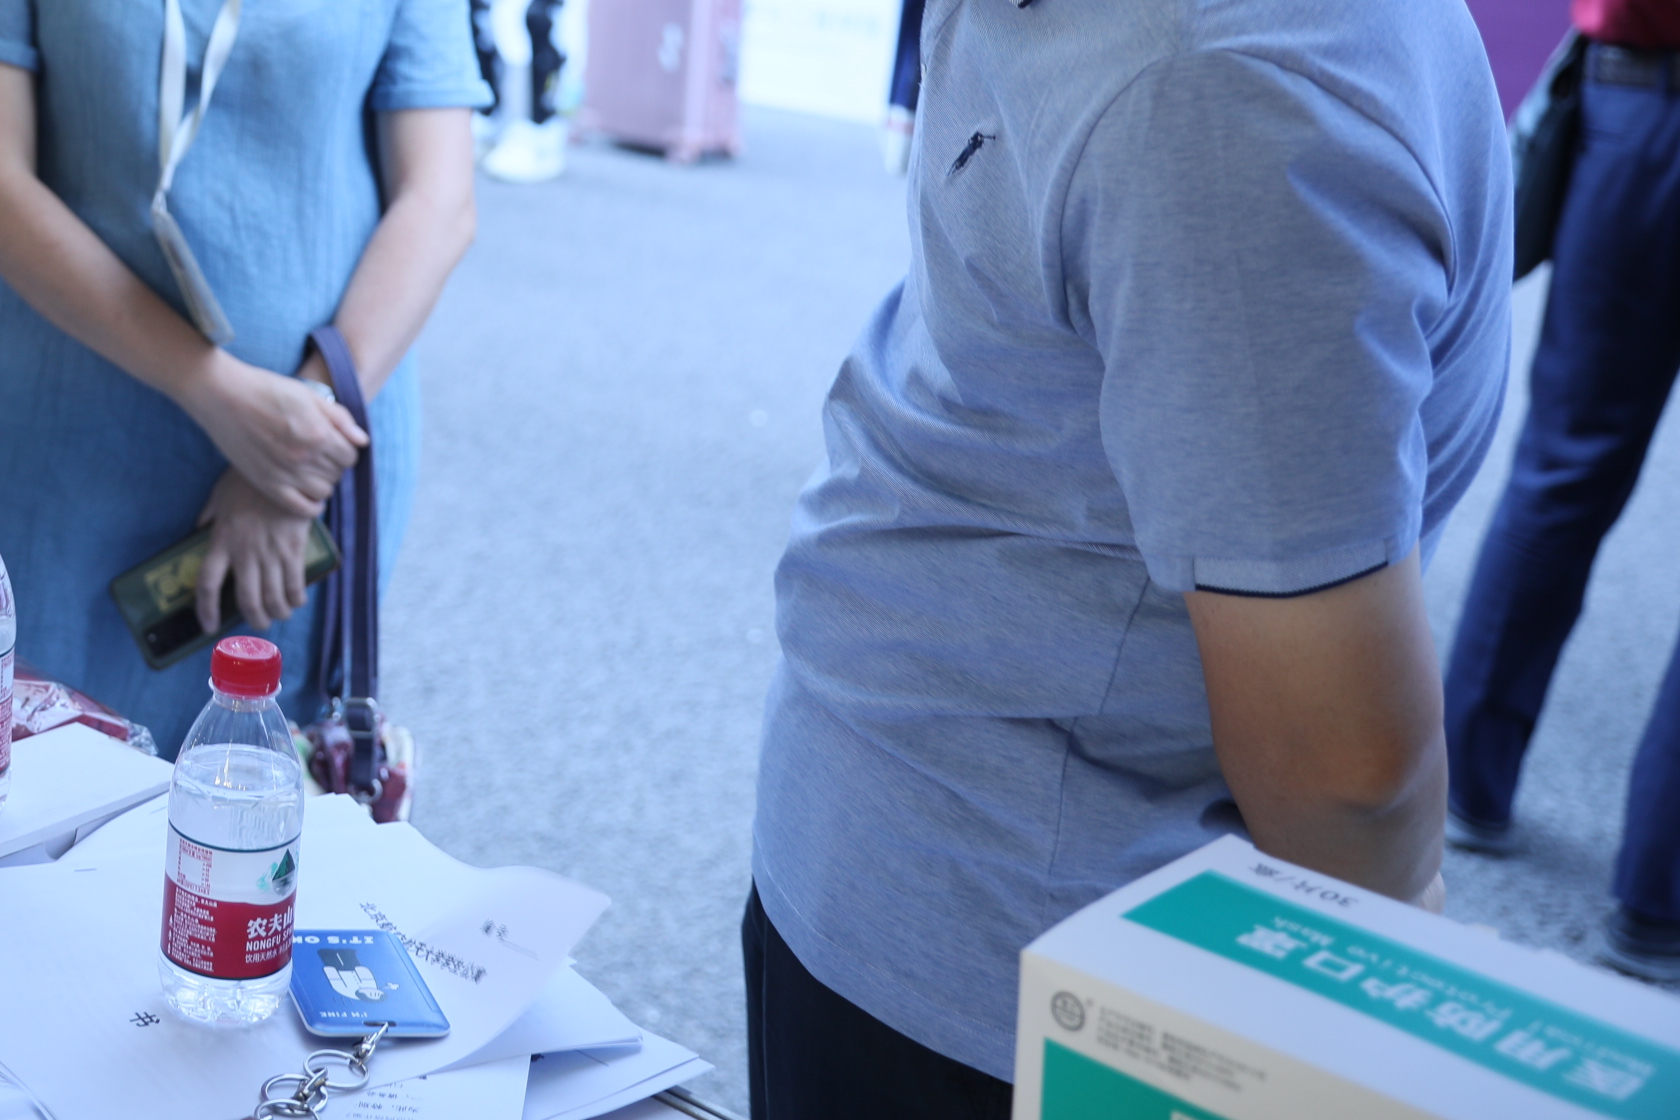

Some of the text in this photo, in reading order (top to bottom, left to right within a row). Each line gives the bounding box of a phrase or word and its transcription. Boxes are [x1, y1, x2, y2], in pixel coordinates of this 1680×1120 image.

[245, 933, 281, 952] NONGFU
[327, 935, 374, 945] IT'S
[1235, 922, 1648, 1102] 医用防护口罩
